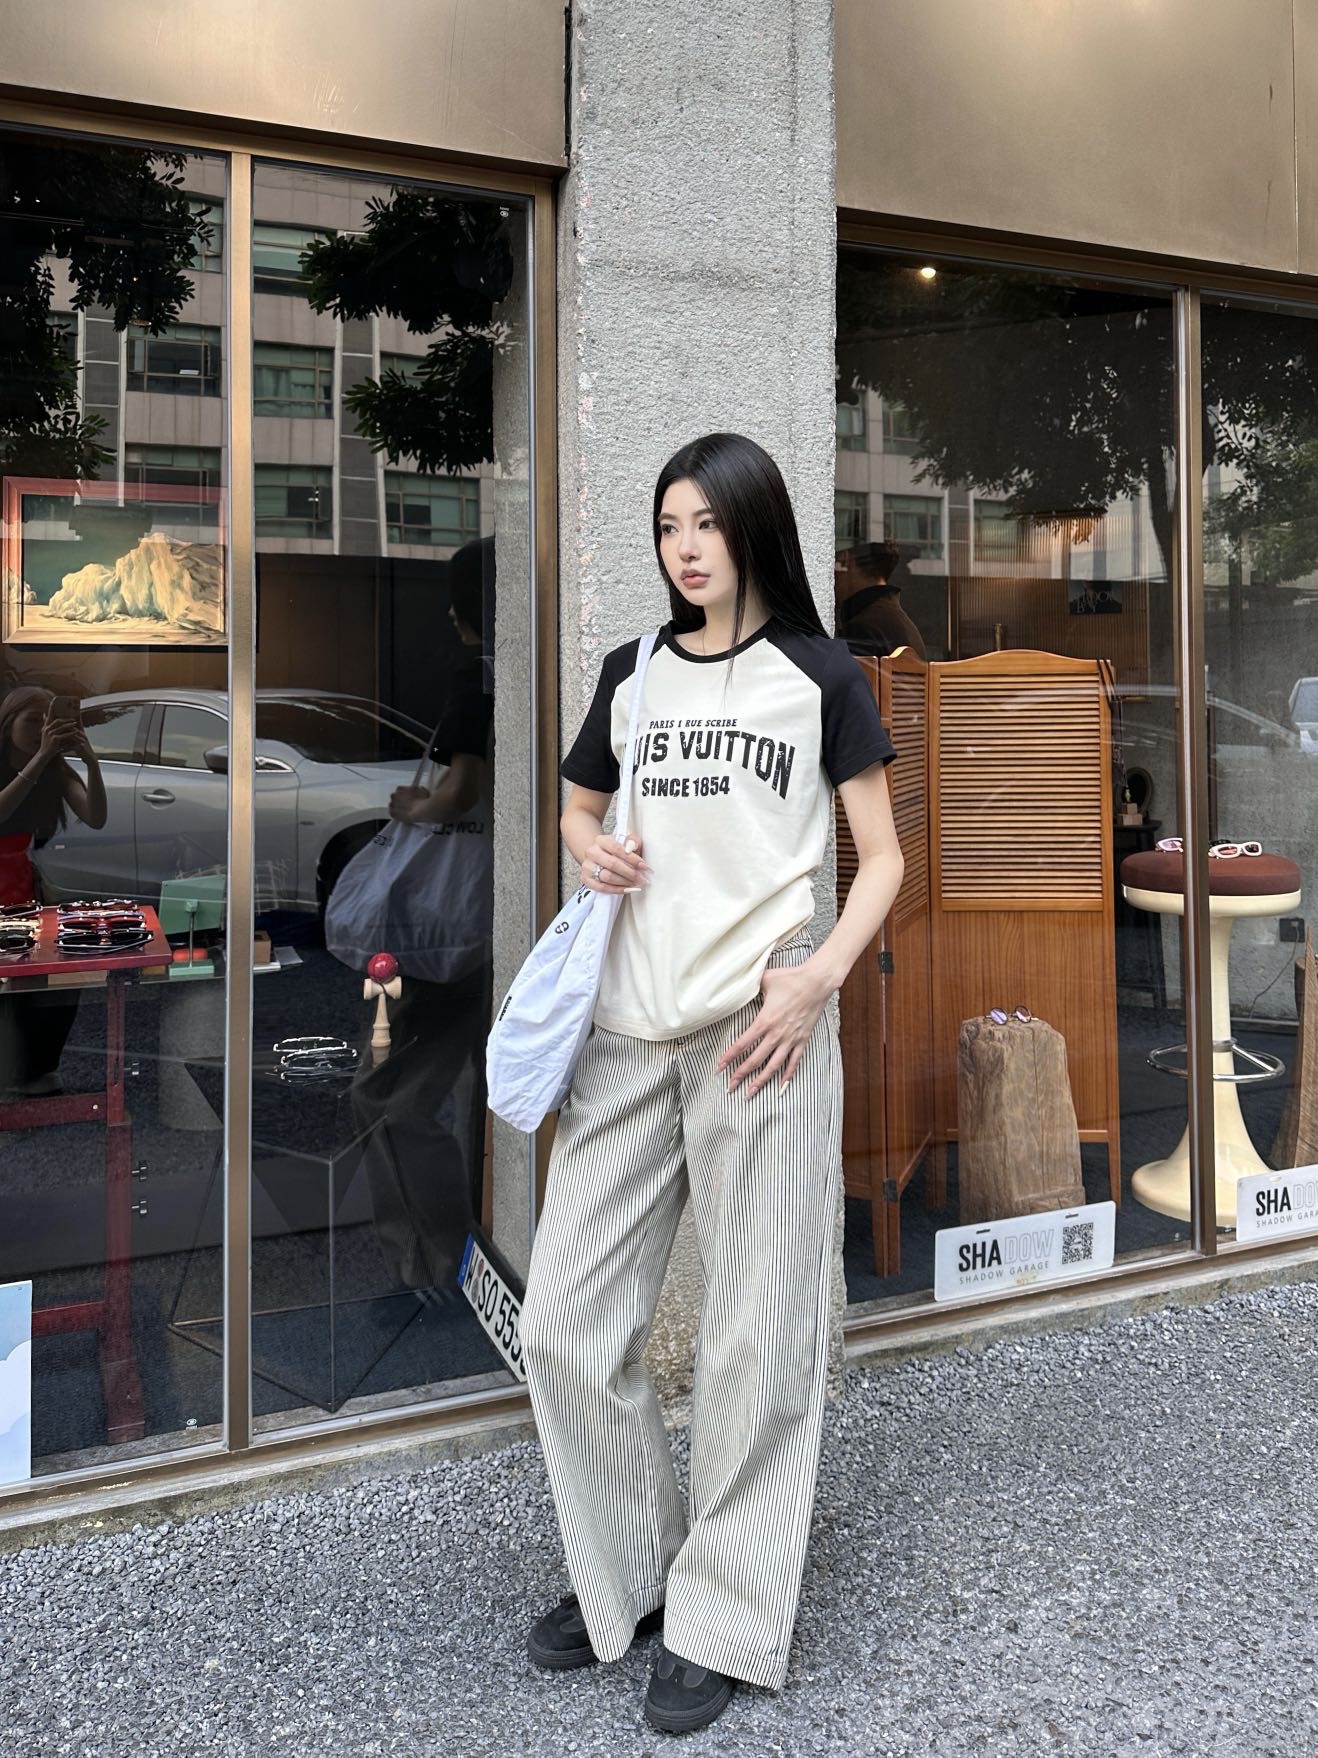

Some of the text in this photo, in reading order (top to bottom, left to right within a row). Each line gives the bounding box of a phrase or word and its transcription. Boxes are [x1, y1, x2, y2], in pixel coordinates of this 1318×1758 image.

[649, 719, 675, 729] PARIS
[685, 719, 703, 728] RUE
[705, 718, 738, 728] SCRIBE
[680, 731, 796, 800] VUITTON
[641, 775, 730, 797] SINCE 1854
[1256, 1214, 1293, 1229] SHADOW
[958, 1228, 1054, 1273] SHADOW
[959, 1260, 1049, 1286] SHADOW GARAGE
